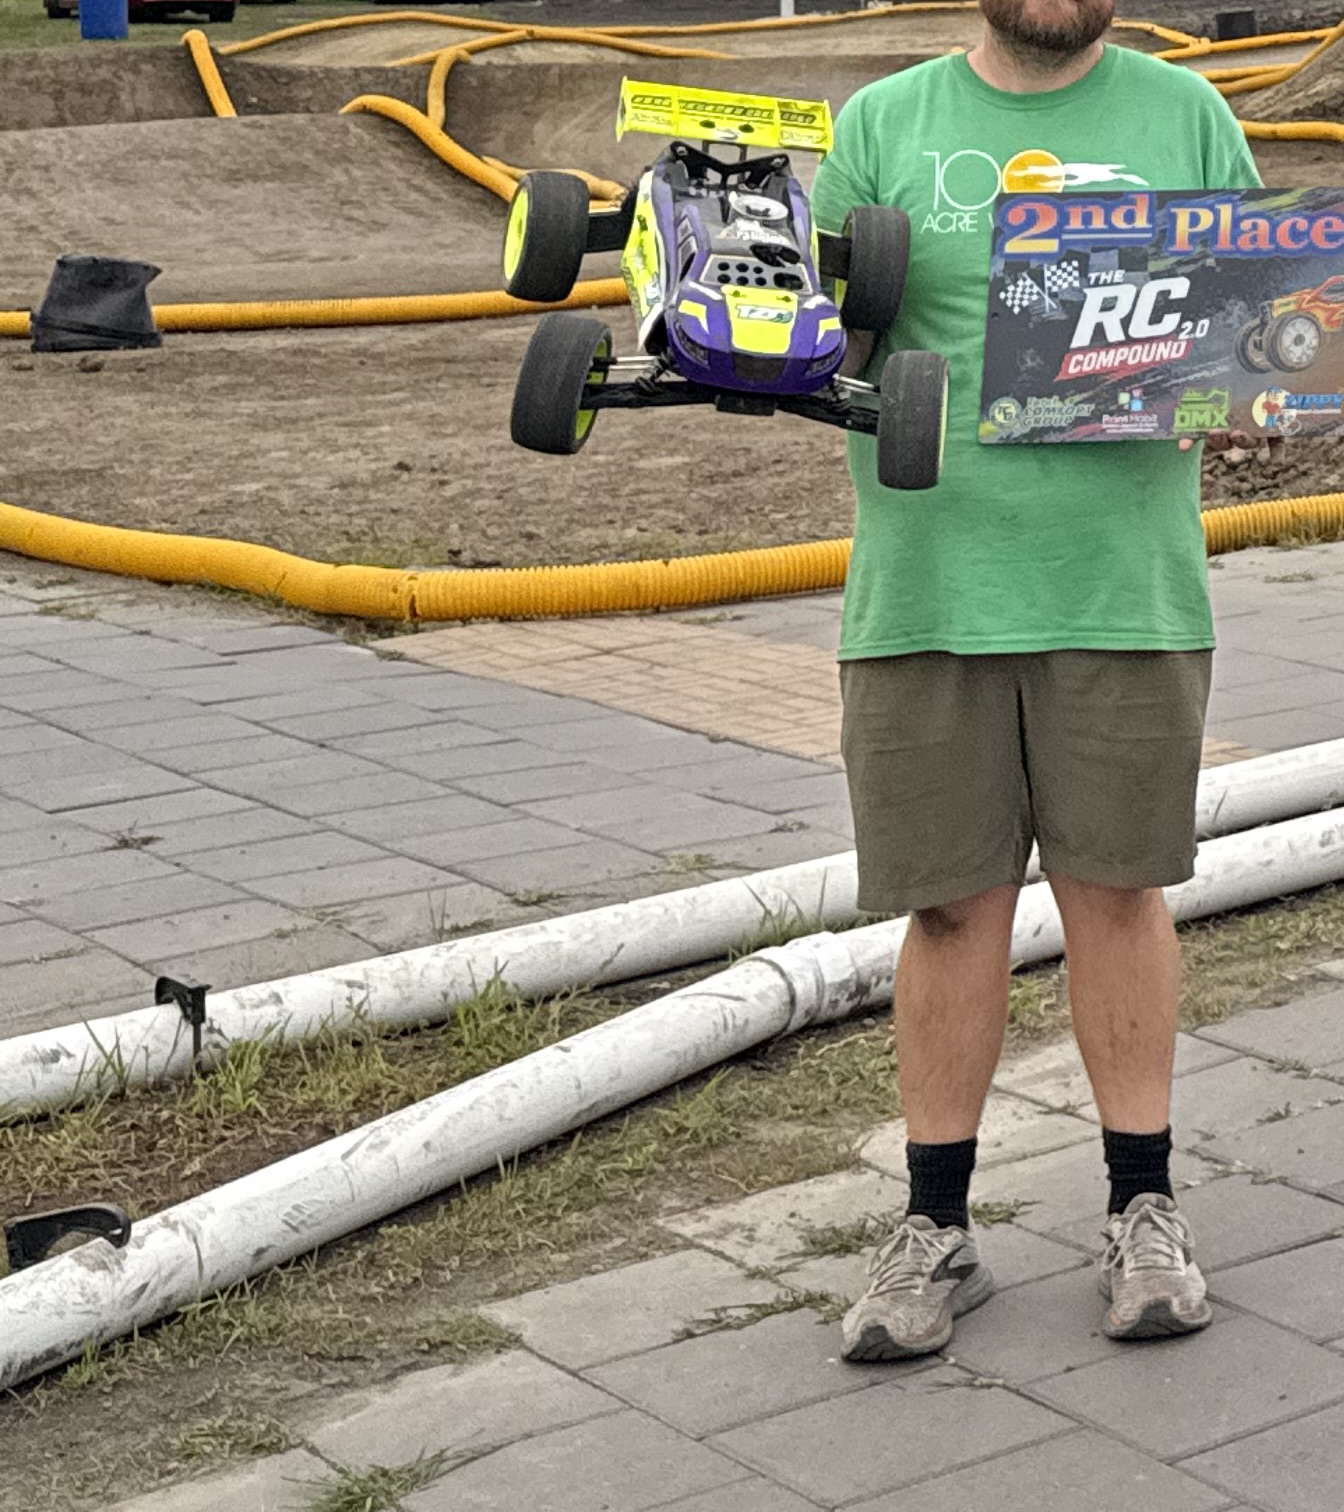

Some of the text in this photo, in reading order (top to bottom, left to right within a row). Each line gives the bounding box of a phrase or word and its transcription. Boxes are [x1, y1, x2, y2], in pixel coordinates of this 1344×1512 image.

[921, 212, 978, 234] ACRE
[1004, 194, 1152, 254] 2nd
[1087, 269, 1126, 285] THE
[1069, 276, 1191, 349] RC
[1178, 318, 1211, 340] 2.0
[1068, 340, 1188, 375] COMPOUND
[1102, 414, 1129, 423] Print
[1175, 409, 1229, 428] DMX
